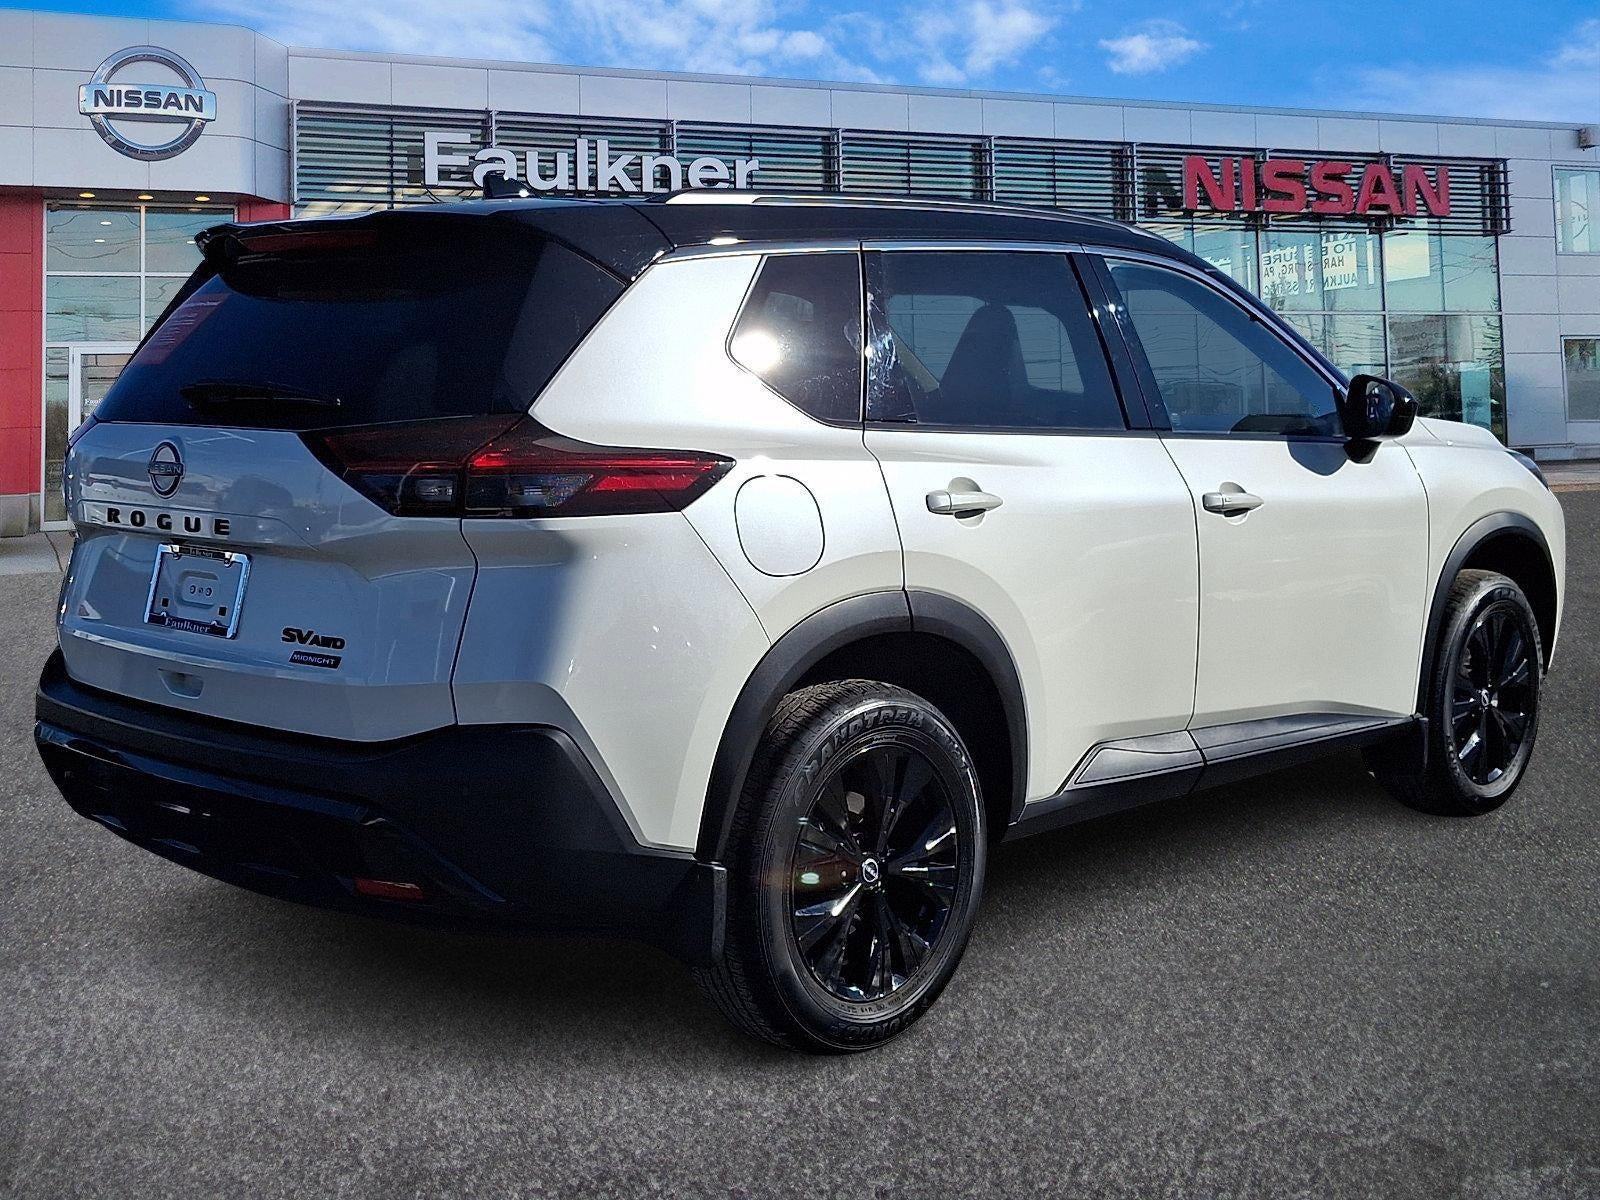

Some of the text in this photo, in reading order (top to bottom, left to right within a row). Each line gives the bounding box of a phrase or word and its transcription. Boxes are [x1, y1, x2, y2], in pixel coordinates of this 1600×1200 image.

[94, 89, 204, 113] NISSAN
[423, 131, 760, 193] Faulkner
[1182, 155, 1451, 217] NISSAN
[107, 507, 230, 536] ROGUE
[165, 617, 211, 634] Faulkner
[292, 653, 336, 666] MIDNIGHT
